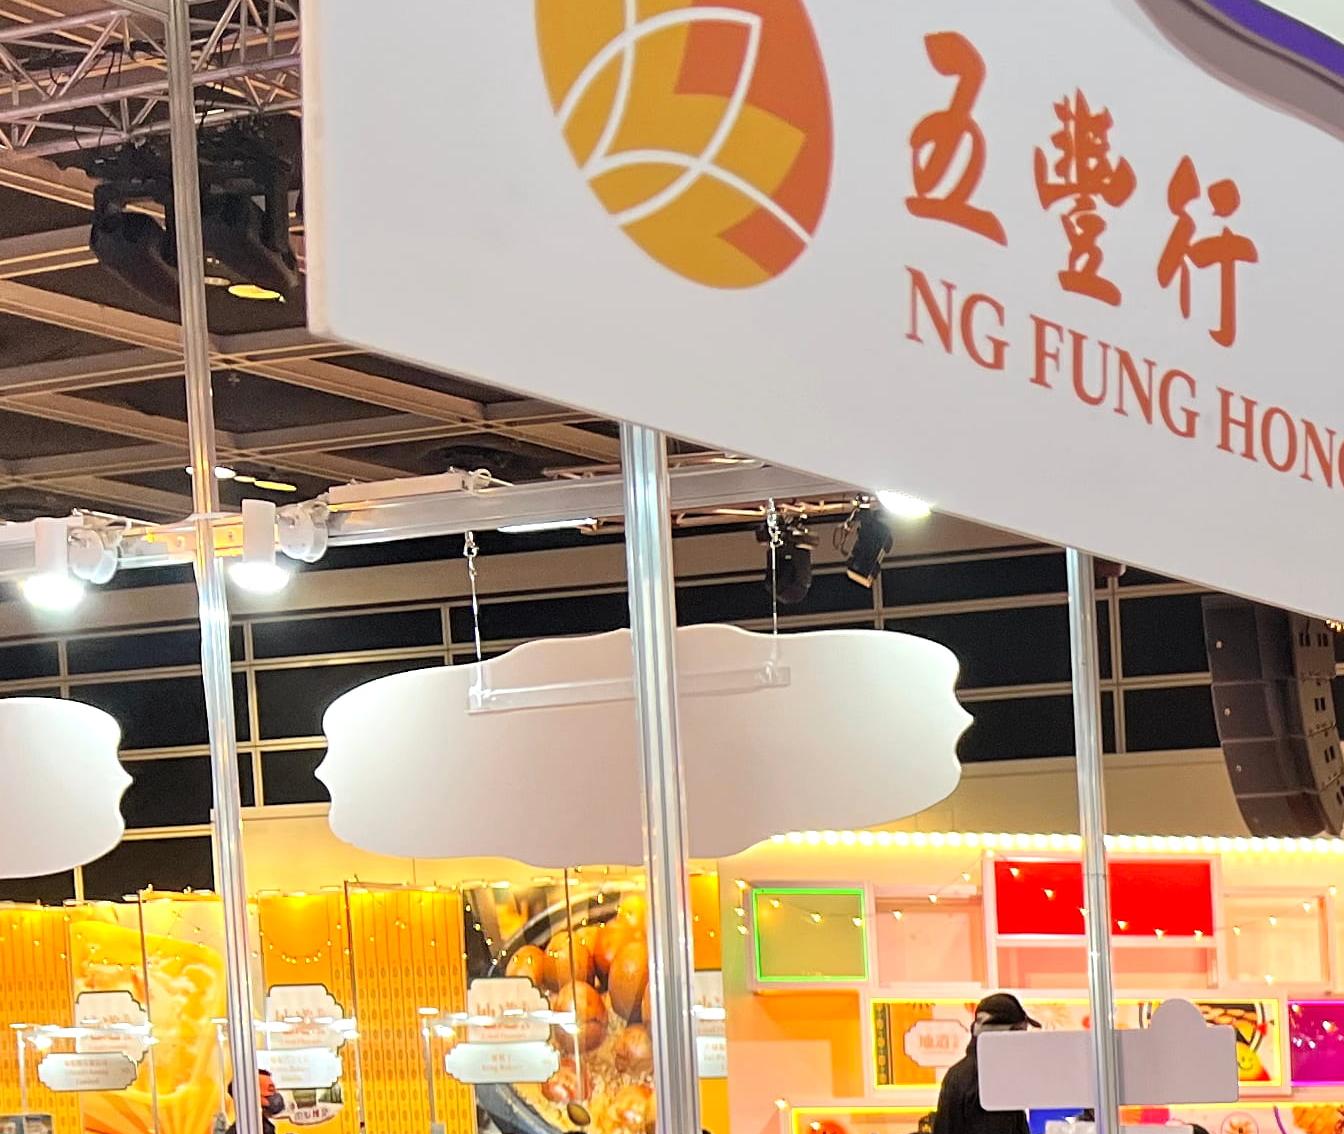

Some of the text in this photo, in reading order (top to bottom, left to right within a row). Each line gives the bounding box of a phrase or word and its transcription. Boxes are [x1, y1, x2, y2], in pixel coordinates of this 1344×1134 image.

[905, 31, 1259, 347] 五豐行
[905, 265, 1009, 371] NG
[1029, 313, 1200, 439] FUNG
